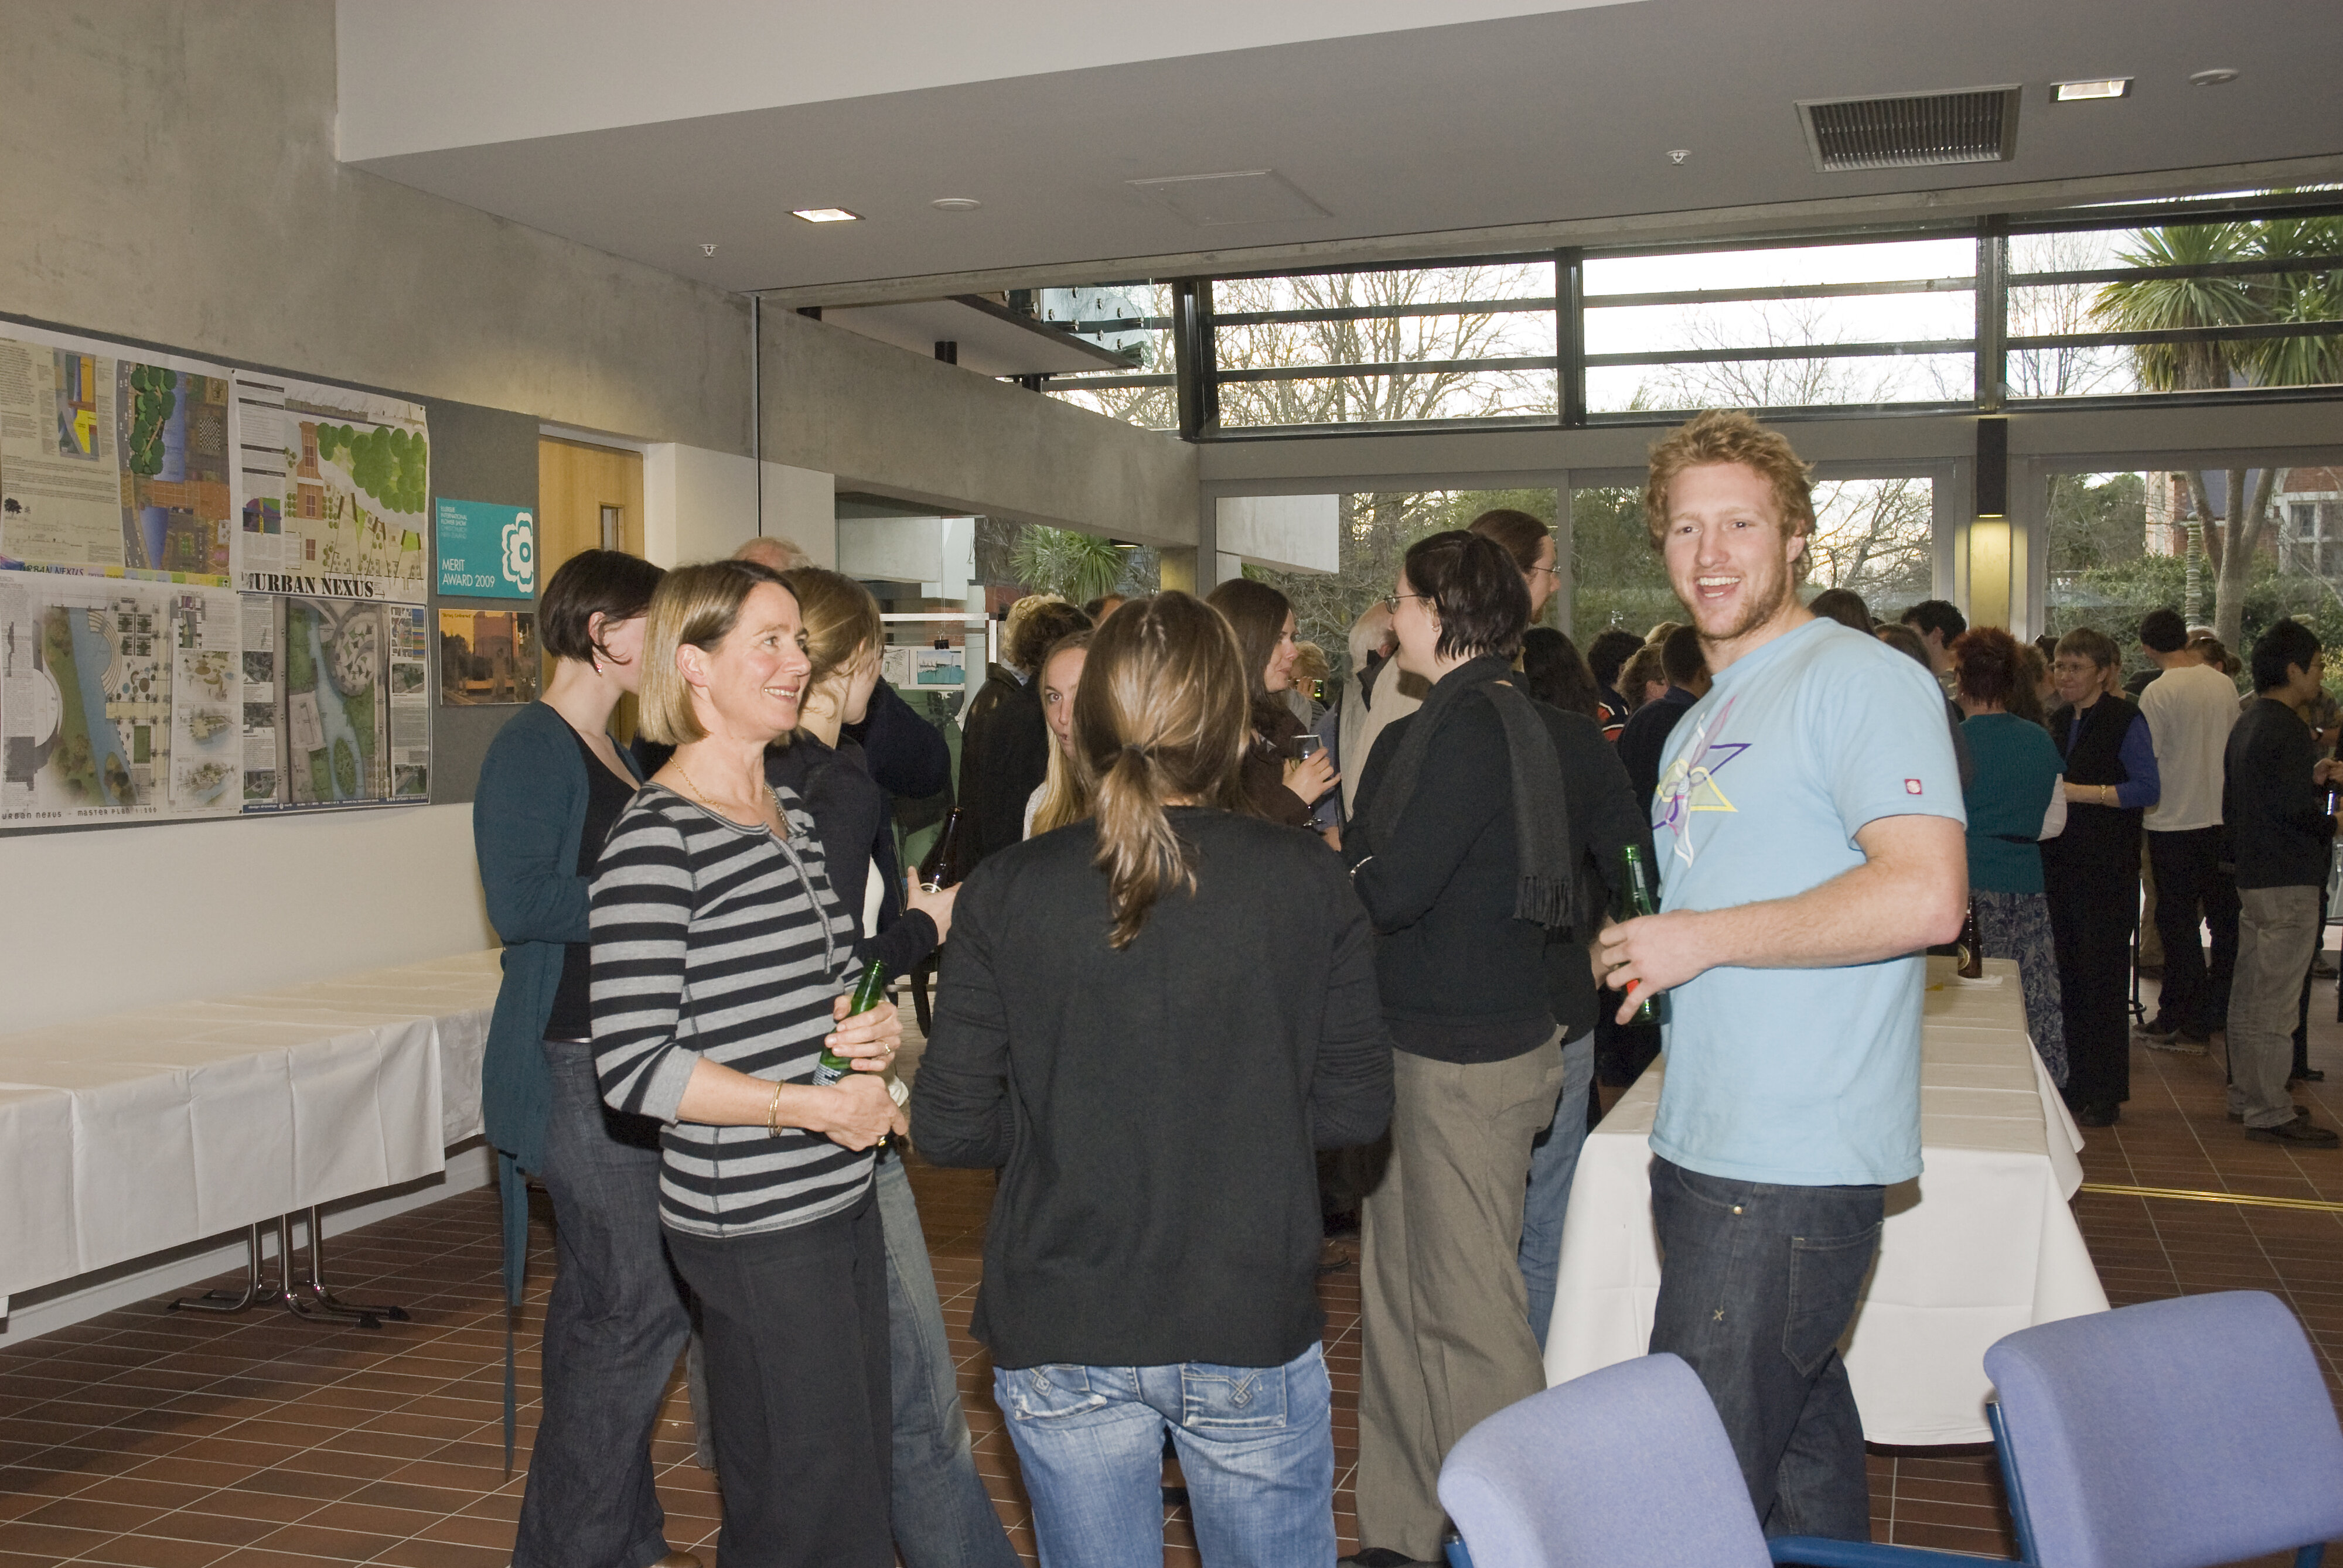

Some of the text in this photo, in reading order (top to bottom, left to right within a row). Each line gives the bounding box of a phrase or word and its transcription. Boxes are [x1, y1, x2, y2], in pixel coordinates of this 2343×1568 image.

[442, 558, 465, 572] MERIT
[255, 573, 374, 597] URBAN NEXUS
[442, 573, 495, 587] AWARD 2009
